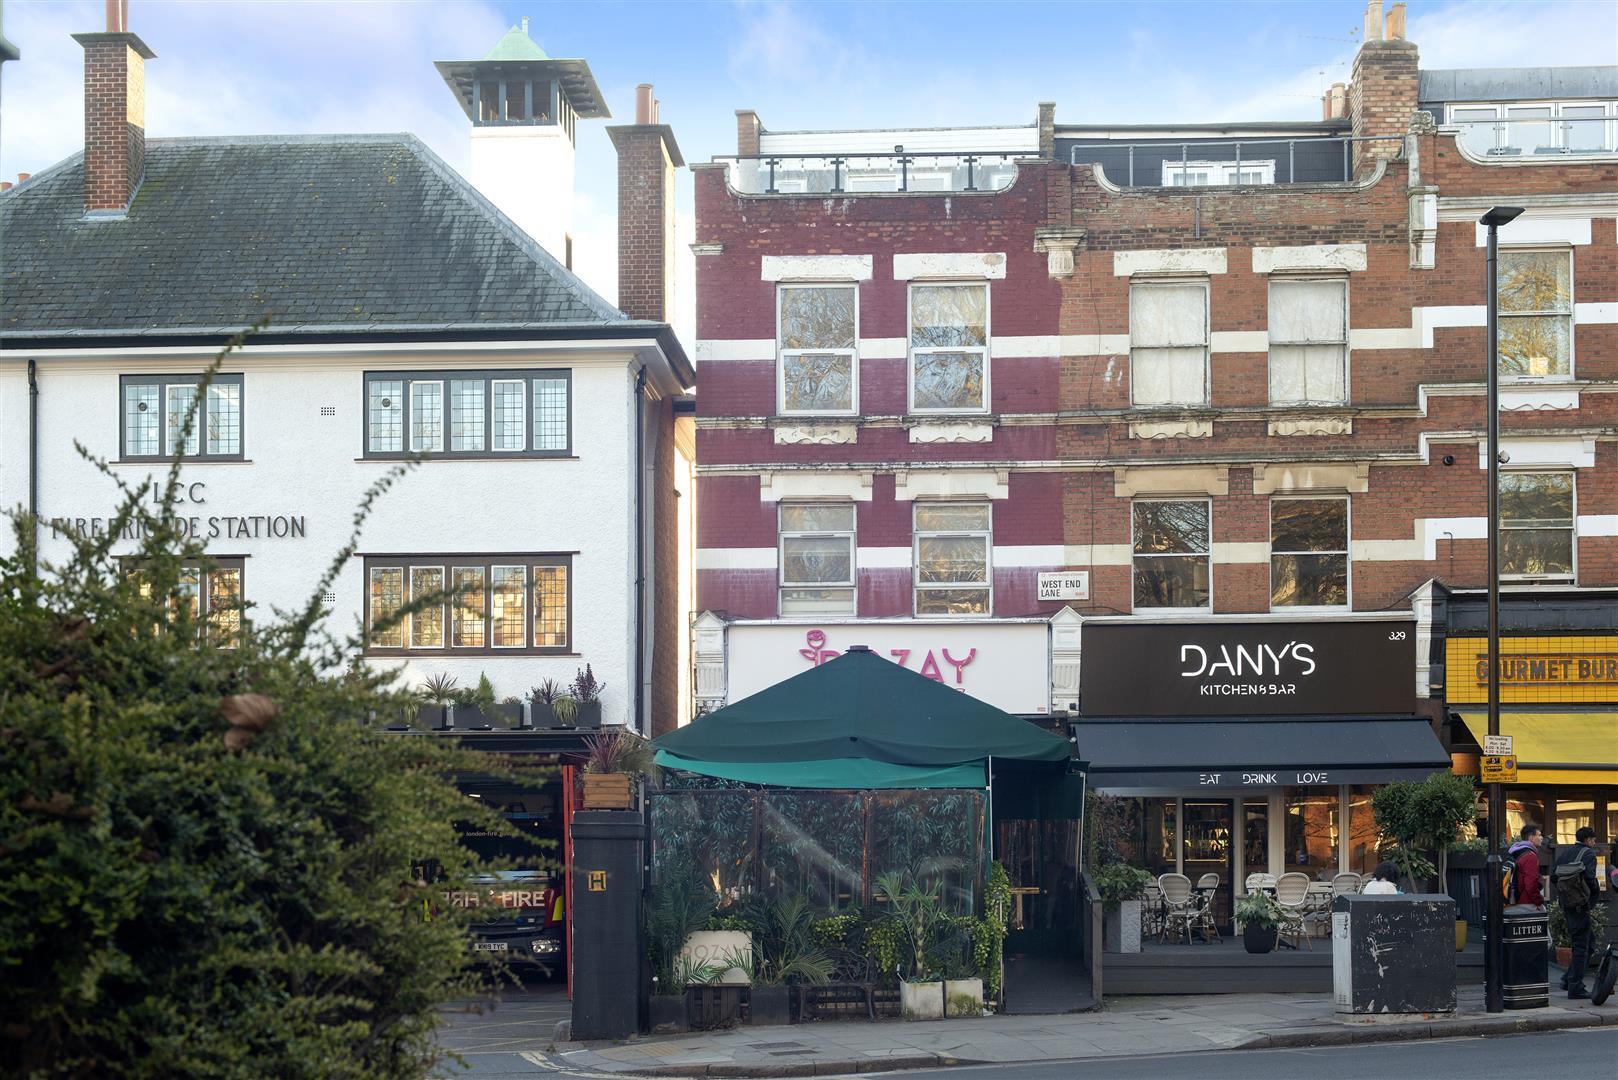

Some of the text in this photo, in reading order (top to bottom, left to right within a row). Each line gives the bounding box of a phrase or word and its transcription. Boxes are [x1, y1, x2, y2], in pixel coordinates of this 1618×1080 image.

[109, 517, 201, 539] RIDE
[208, 516, 305, 539] STATION
[1041, 580, 1081, 589] WEST END
[1041, 589, 1061, 598] LANE
[1388, 631, 1406, 640] 329
[1181, 641, 1316, 677] DANY'S
[1476, 658, 1572, 681] GURMET
[1199, 772, 1328, 785] EAT DRINK LOVE
[502, 891, 545, 908] FIRE
[1512, 925, 1542, 936] LITTER
